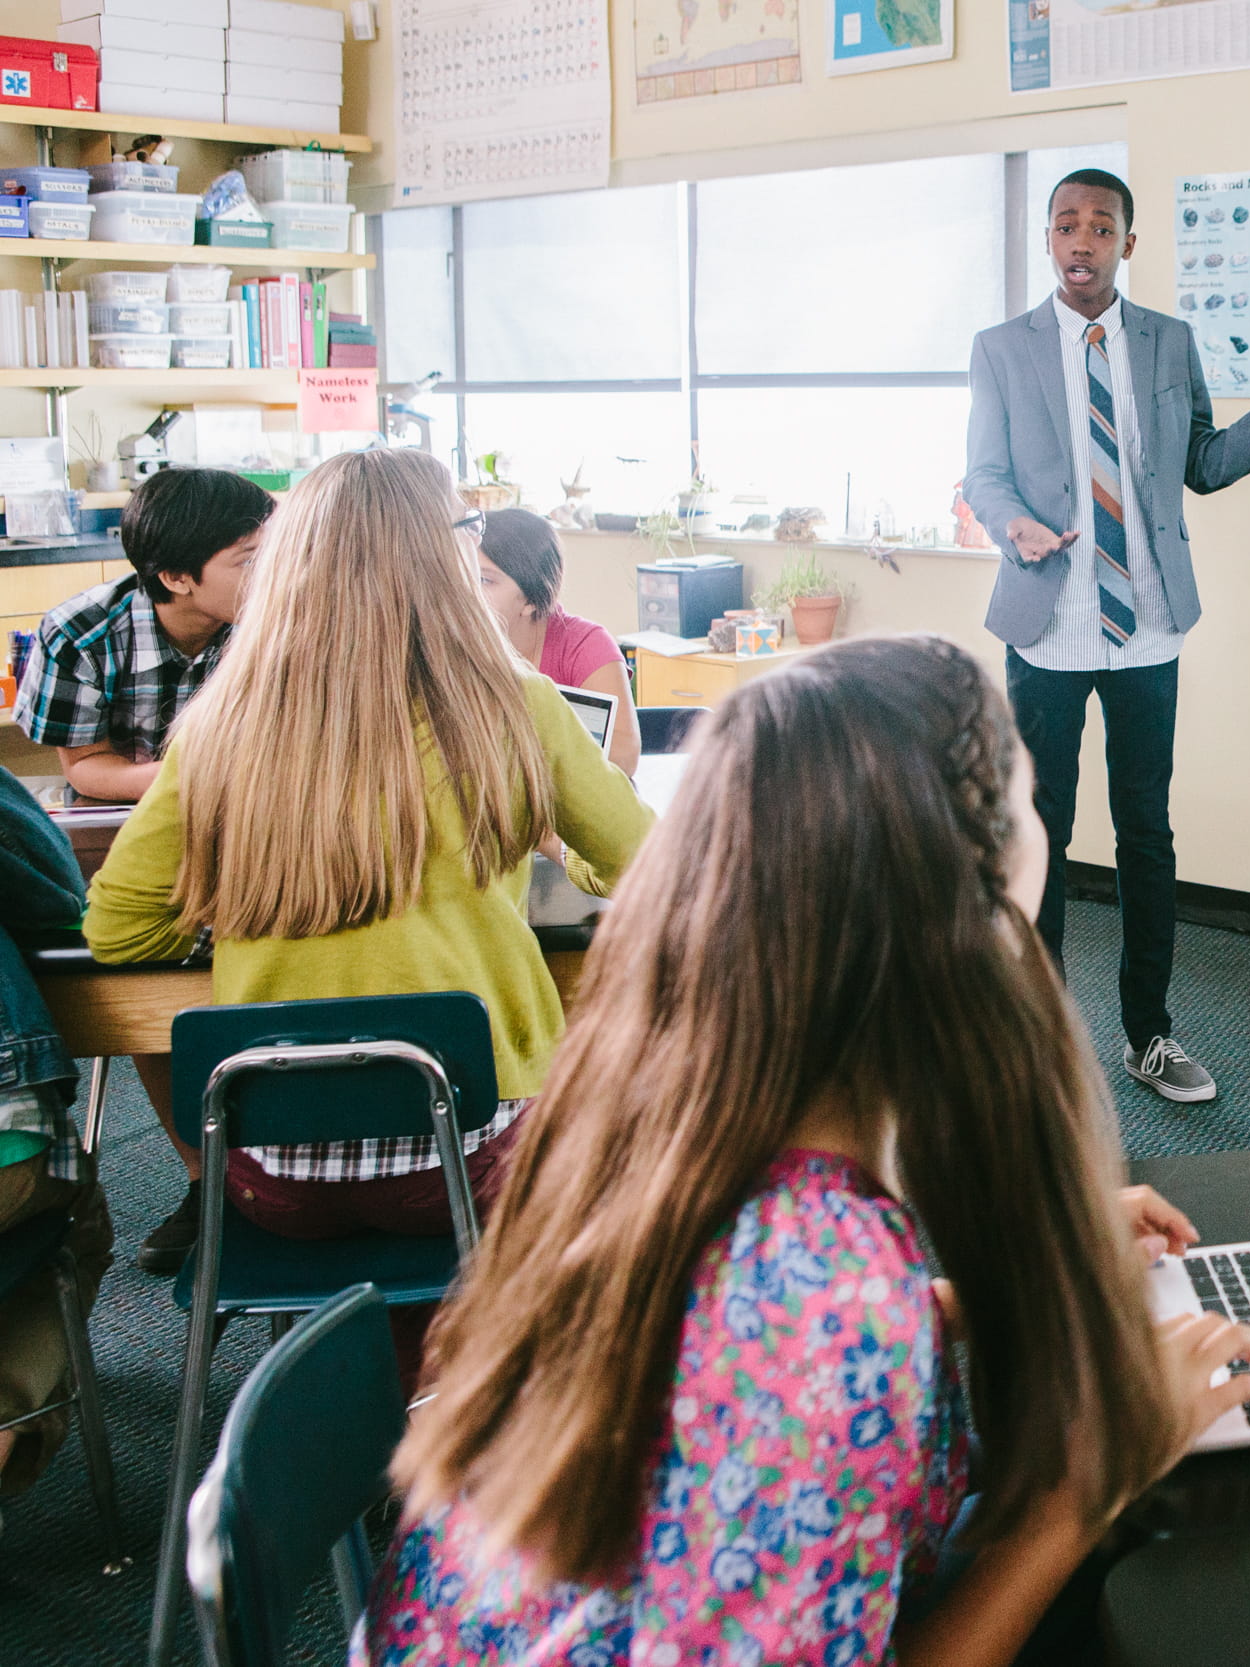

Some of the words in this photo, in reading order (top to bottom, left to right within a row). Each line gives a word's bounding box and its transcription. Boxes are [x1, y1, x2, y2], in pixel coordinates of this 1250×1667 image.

[45, 183, 83, 192] SCISSORS
[1183, 180, 1217, 193] Rocks
[1221, 179, 1244, 190] and
[306, 377, 369, 388] Nameless
[319, 393, 358, 403] Work
